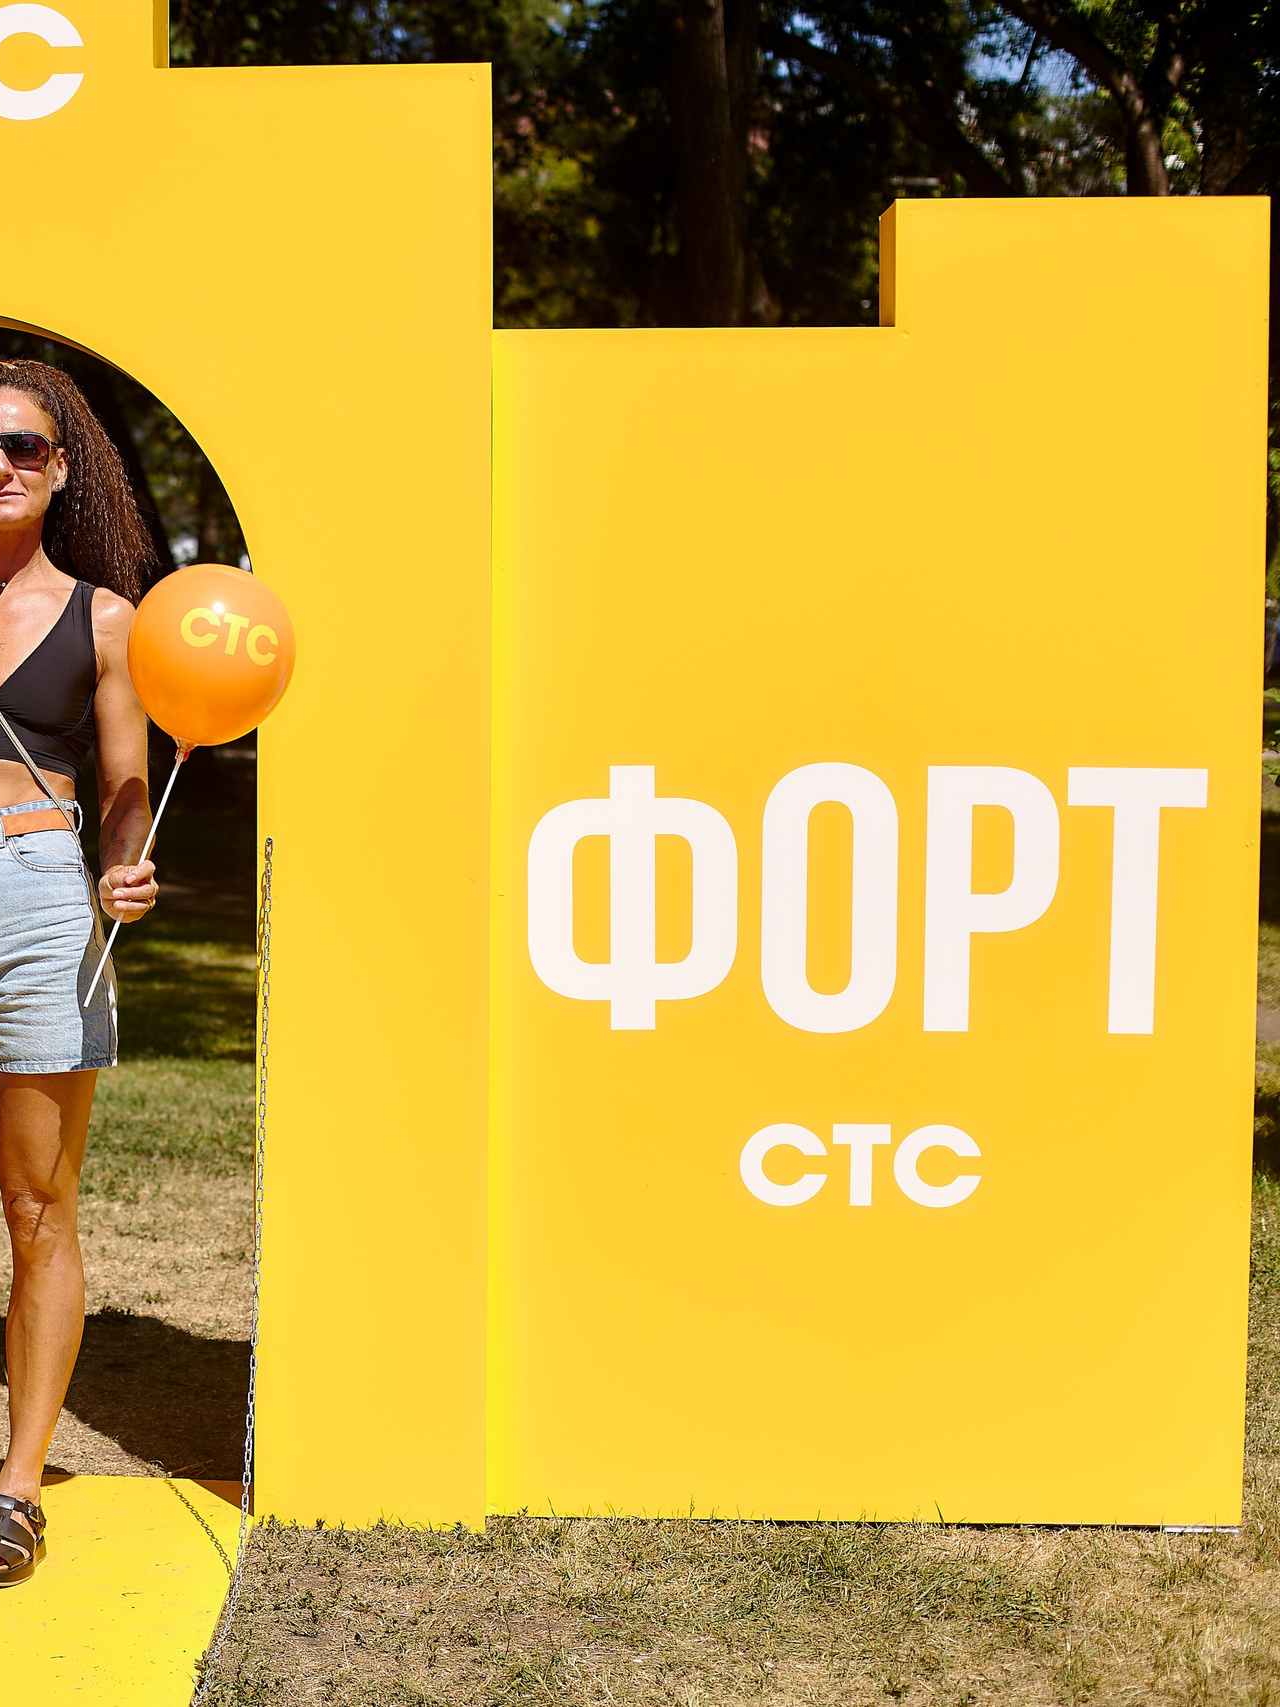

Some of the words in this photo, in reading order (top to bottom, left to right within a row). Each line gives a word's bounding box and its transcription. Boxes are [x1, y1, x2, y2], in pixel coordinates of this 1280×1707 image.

[180, 607, 278, 666] СТС
[527, 761, 1209, 1035] ФОРТ
[739, 1123, 982, 1208] СТС
